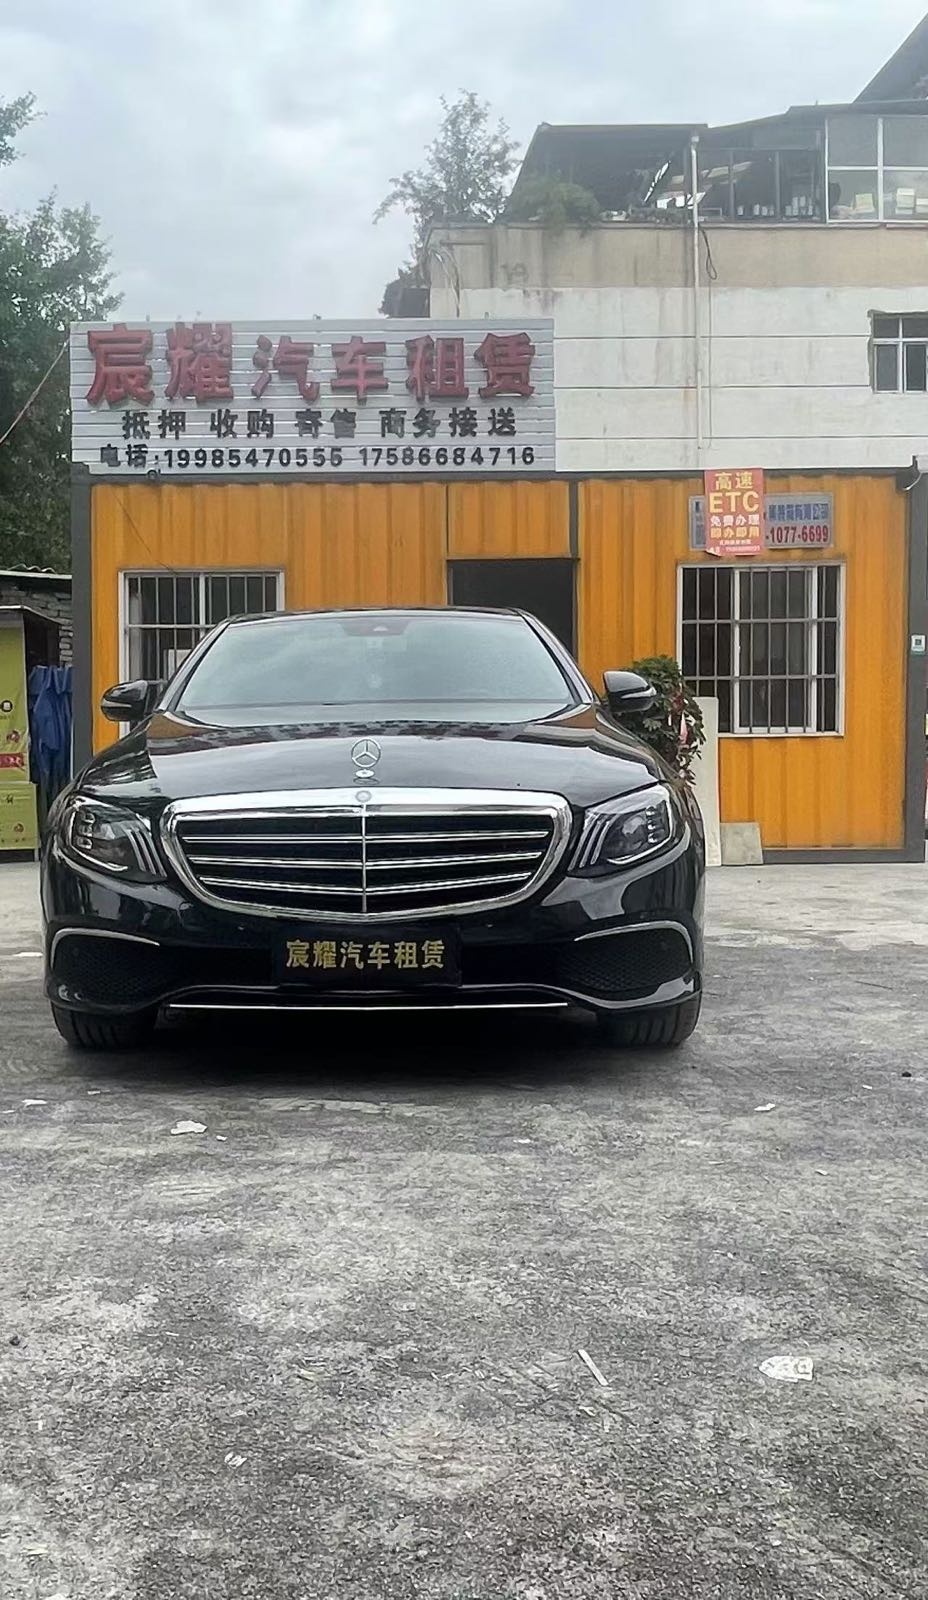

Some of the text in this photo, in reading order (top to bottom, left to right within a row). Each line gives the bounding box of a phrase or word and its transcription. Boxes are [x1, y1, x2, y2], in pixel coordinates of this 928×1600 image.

[87, 323, 536, 406] 宸耀汽车租赁
[122, 409, 187, 440] 抵押
[210, 408, 274, 439] 收购
[379, 407, 517, 438] 商务接送
[359, 447, 535, 467] 17586684716
[715, 471, 753, 490] 高速
[709, 490, 760, 513] ETC
[711, 514, 760, 527] 免费办理
[286, 939, 445, 970] 宸耀汽车租赁
